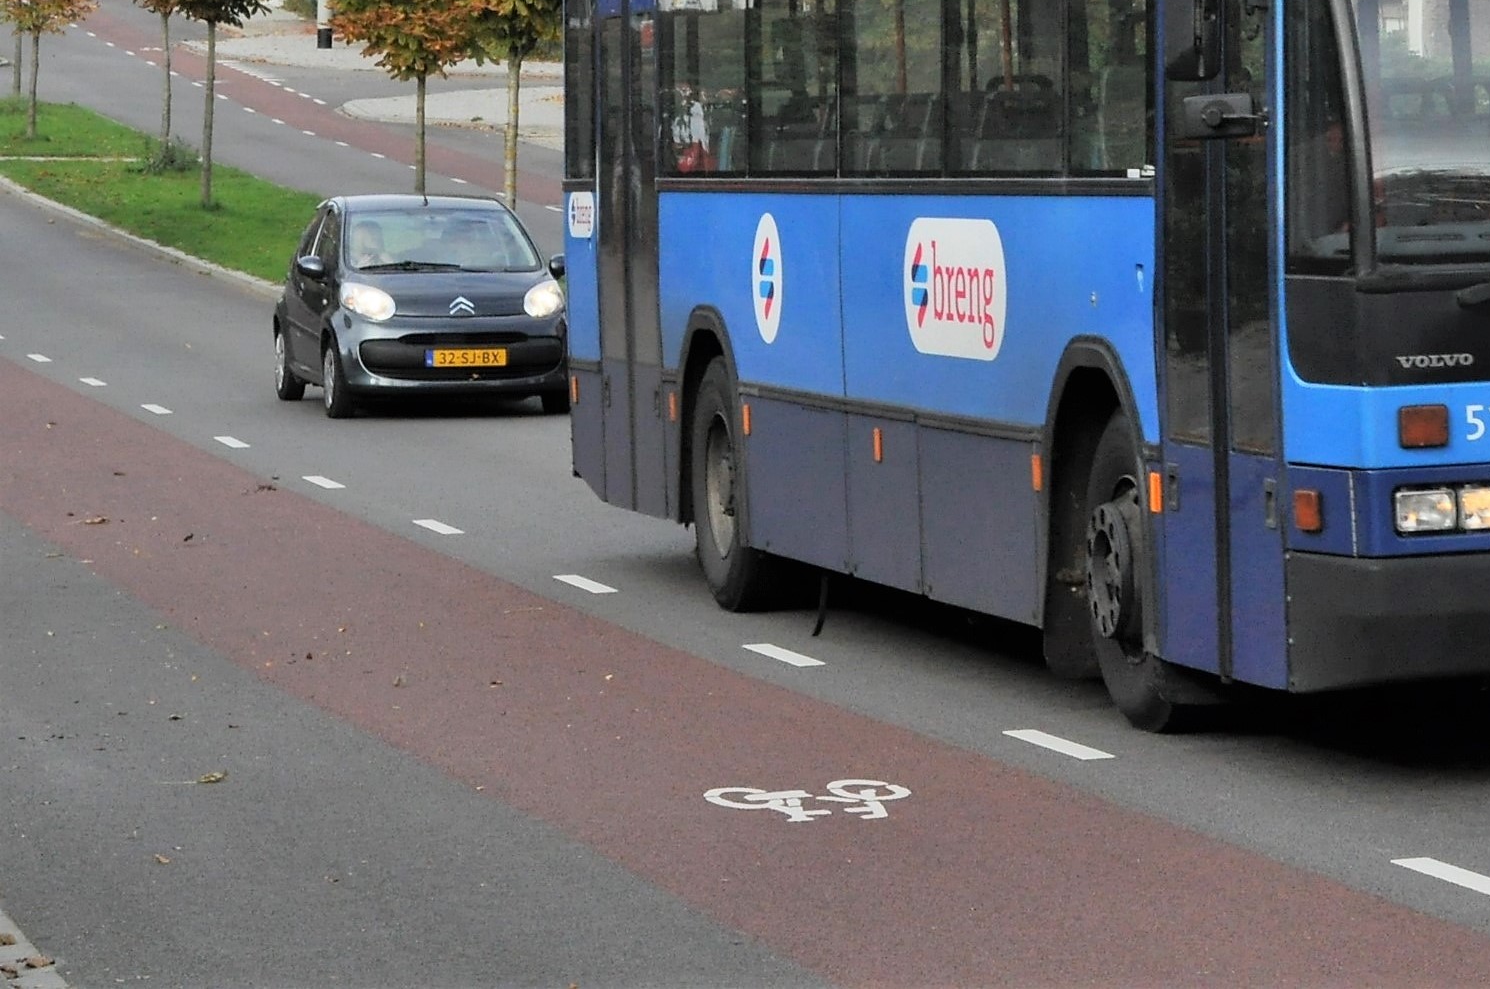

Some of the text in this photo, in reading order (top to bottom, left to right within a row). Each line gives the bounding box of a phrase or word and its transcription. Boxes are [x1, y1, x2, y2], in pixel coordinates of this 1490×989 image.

[931, 240, 995, 349] breng
[439, 352, 499, 364] 32-SJ-BX
[1396, 353, 1474, 368] VOLVO
